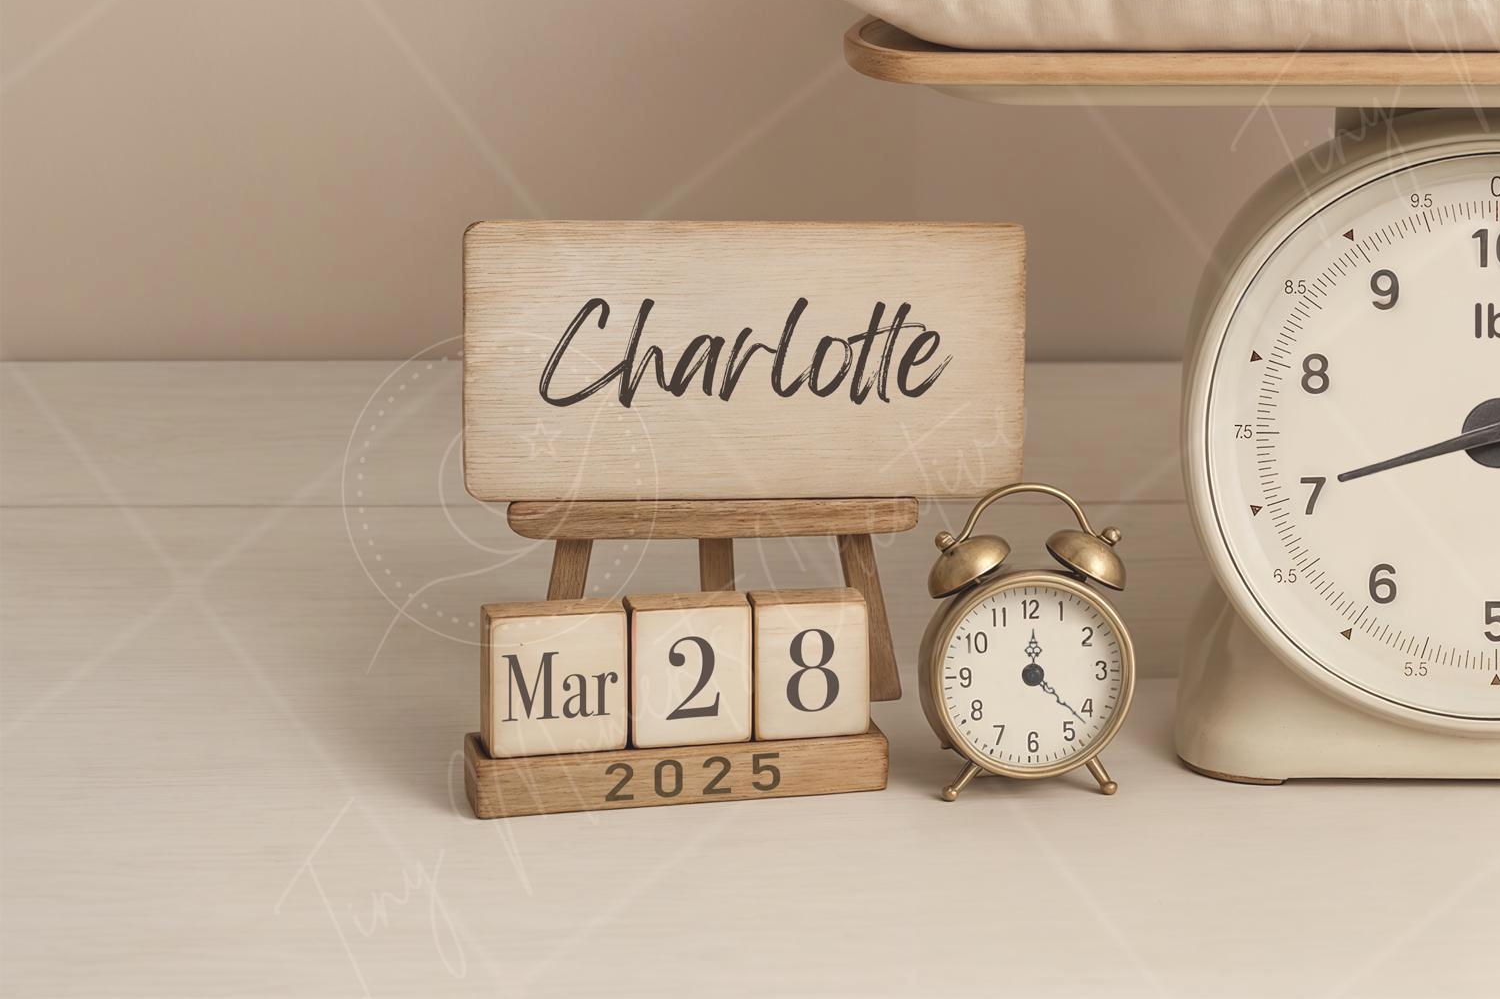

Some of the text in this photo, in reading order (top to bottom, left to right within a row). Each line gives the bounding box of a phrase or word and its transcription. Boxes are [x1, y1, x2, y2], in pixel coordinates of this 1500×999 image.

[1410, 193, 1432, 208] 9.5
[1284, 280, 1306, 295] 8.5
[1370, 270, 1400, 310] 9
[539, 297, 953, 408] Charlotte
[1301, 354, 1330, 394] 8
[1234, 425, 1253, 439] 7.5
[1300, 477, 1327, 515] 7
[1274, 569, 1297, 584] 6.5
[1369, 563, 1397, 604] 6
[992, 607, 1007, 628] 11
[1022, 599, 1040, 620] 12
[1058, 601, 1064, 621] 1
[965, 631, 988, 653] 10
[1081, 627, 1094, 647] 2
[959, 667, 972, 688] 9
[1095, 661, 1108, 681] 3
[1403, 662, 1428, 677] 5.5
[501, 651, 619, 723] Mar
[970, 699, 983, 721] 8
[1081, 698, 1094, 718] 4
[993, 725, 1005, 746] 7
[1063, 721, 1076, 742] 5
[1027, 732, 1040, 753] 6
[604, 751, 782, 802] 2025
